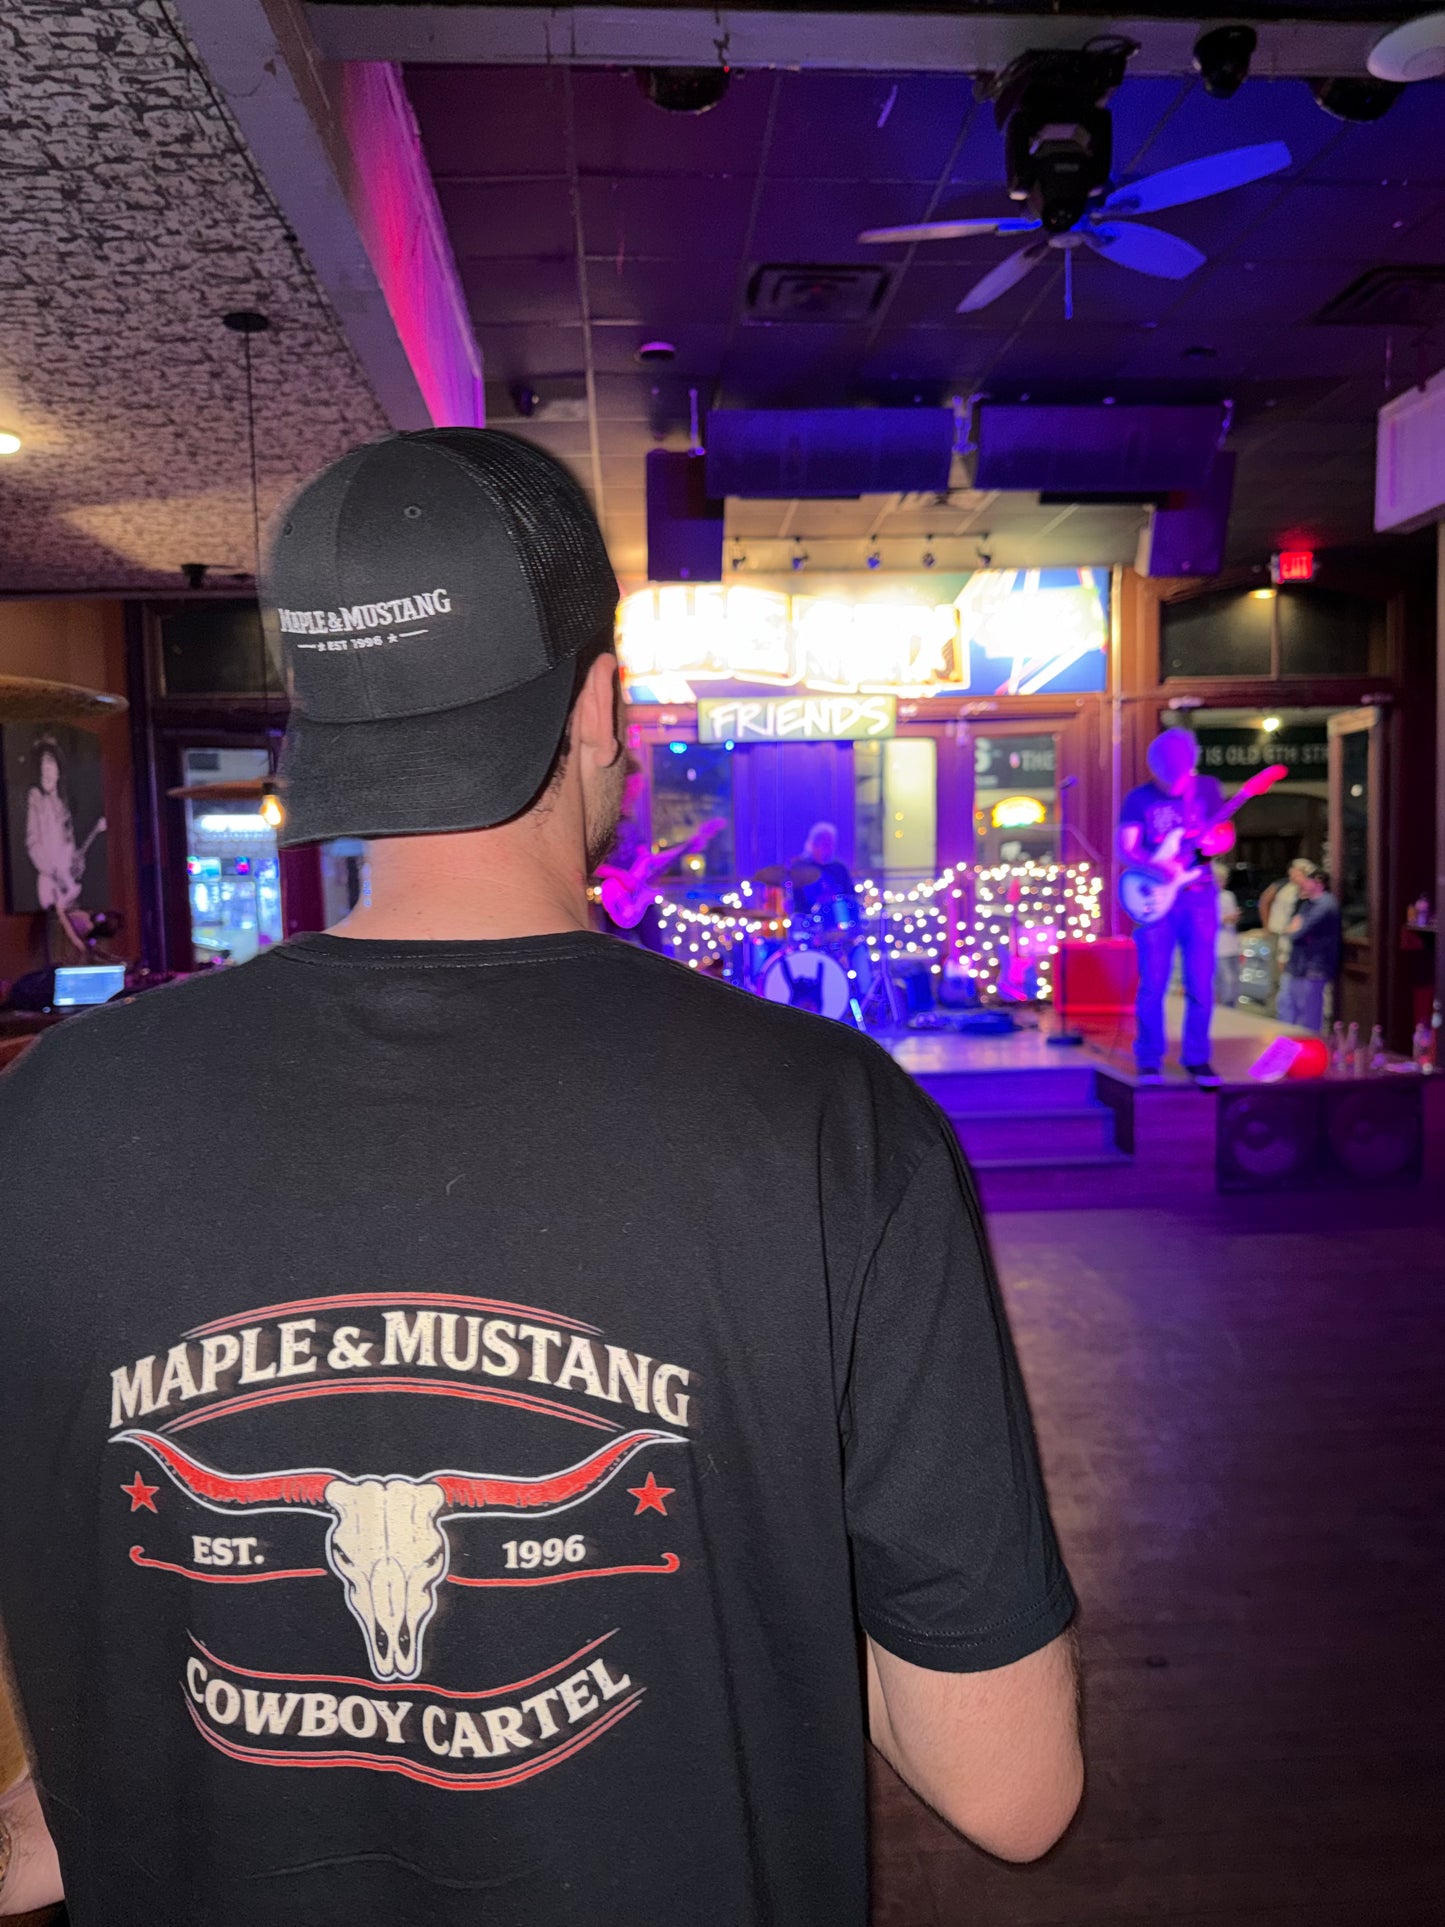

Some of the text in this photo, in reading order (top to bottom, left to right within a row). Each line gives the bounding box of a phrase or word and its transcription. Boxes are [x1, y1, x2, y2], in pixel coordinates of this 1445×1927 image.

[338, 589, 451, 632] MUSTANG
[327, 635, 384, 651] EST 1996
[711, 697, 890, 739] FRIENDS
[109, 1310, 691, 1429] MAPLE & MUSTANG
[191, 1533, 587, 1570] EST. 1996
[186, 1656, 632, 1759] COWBOY CARTEL
